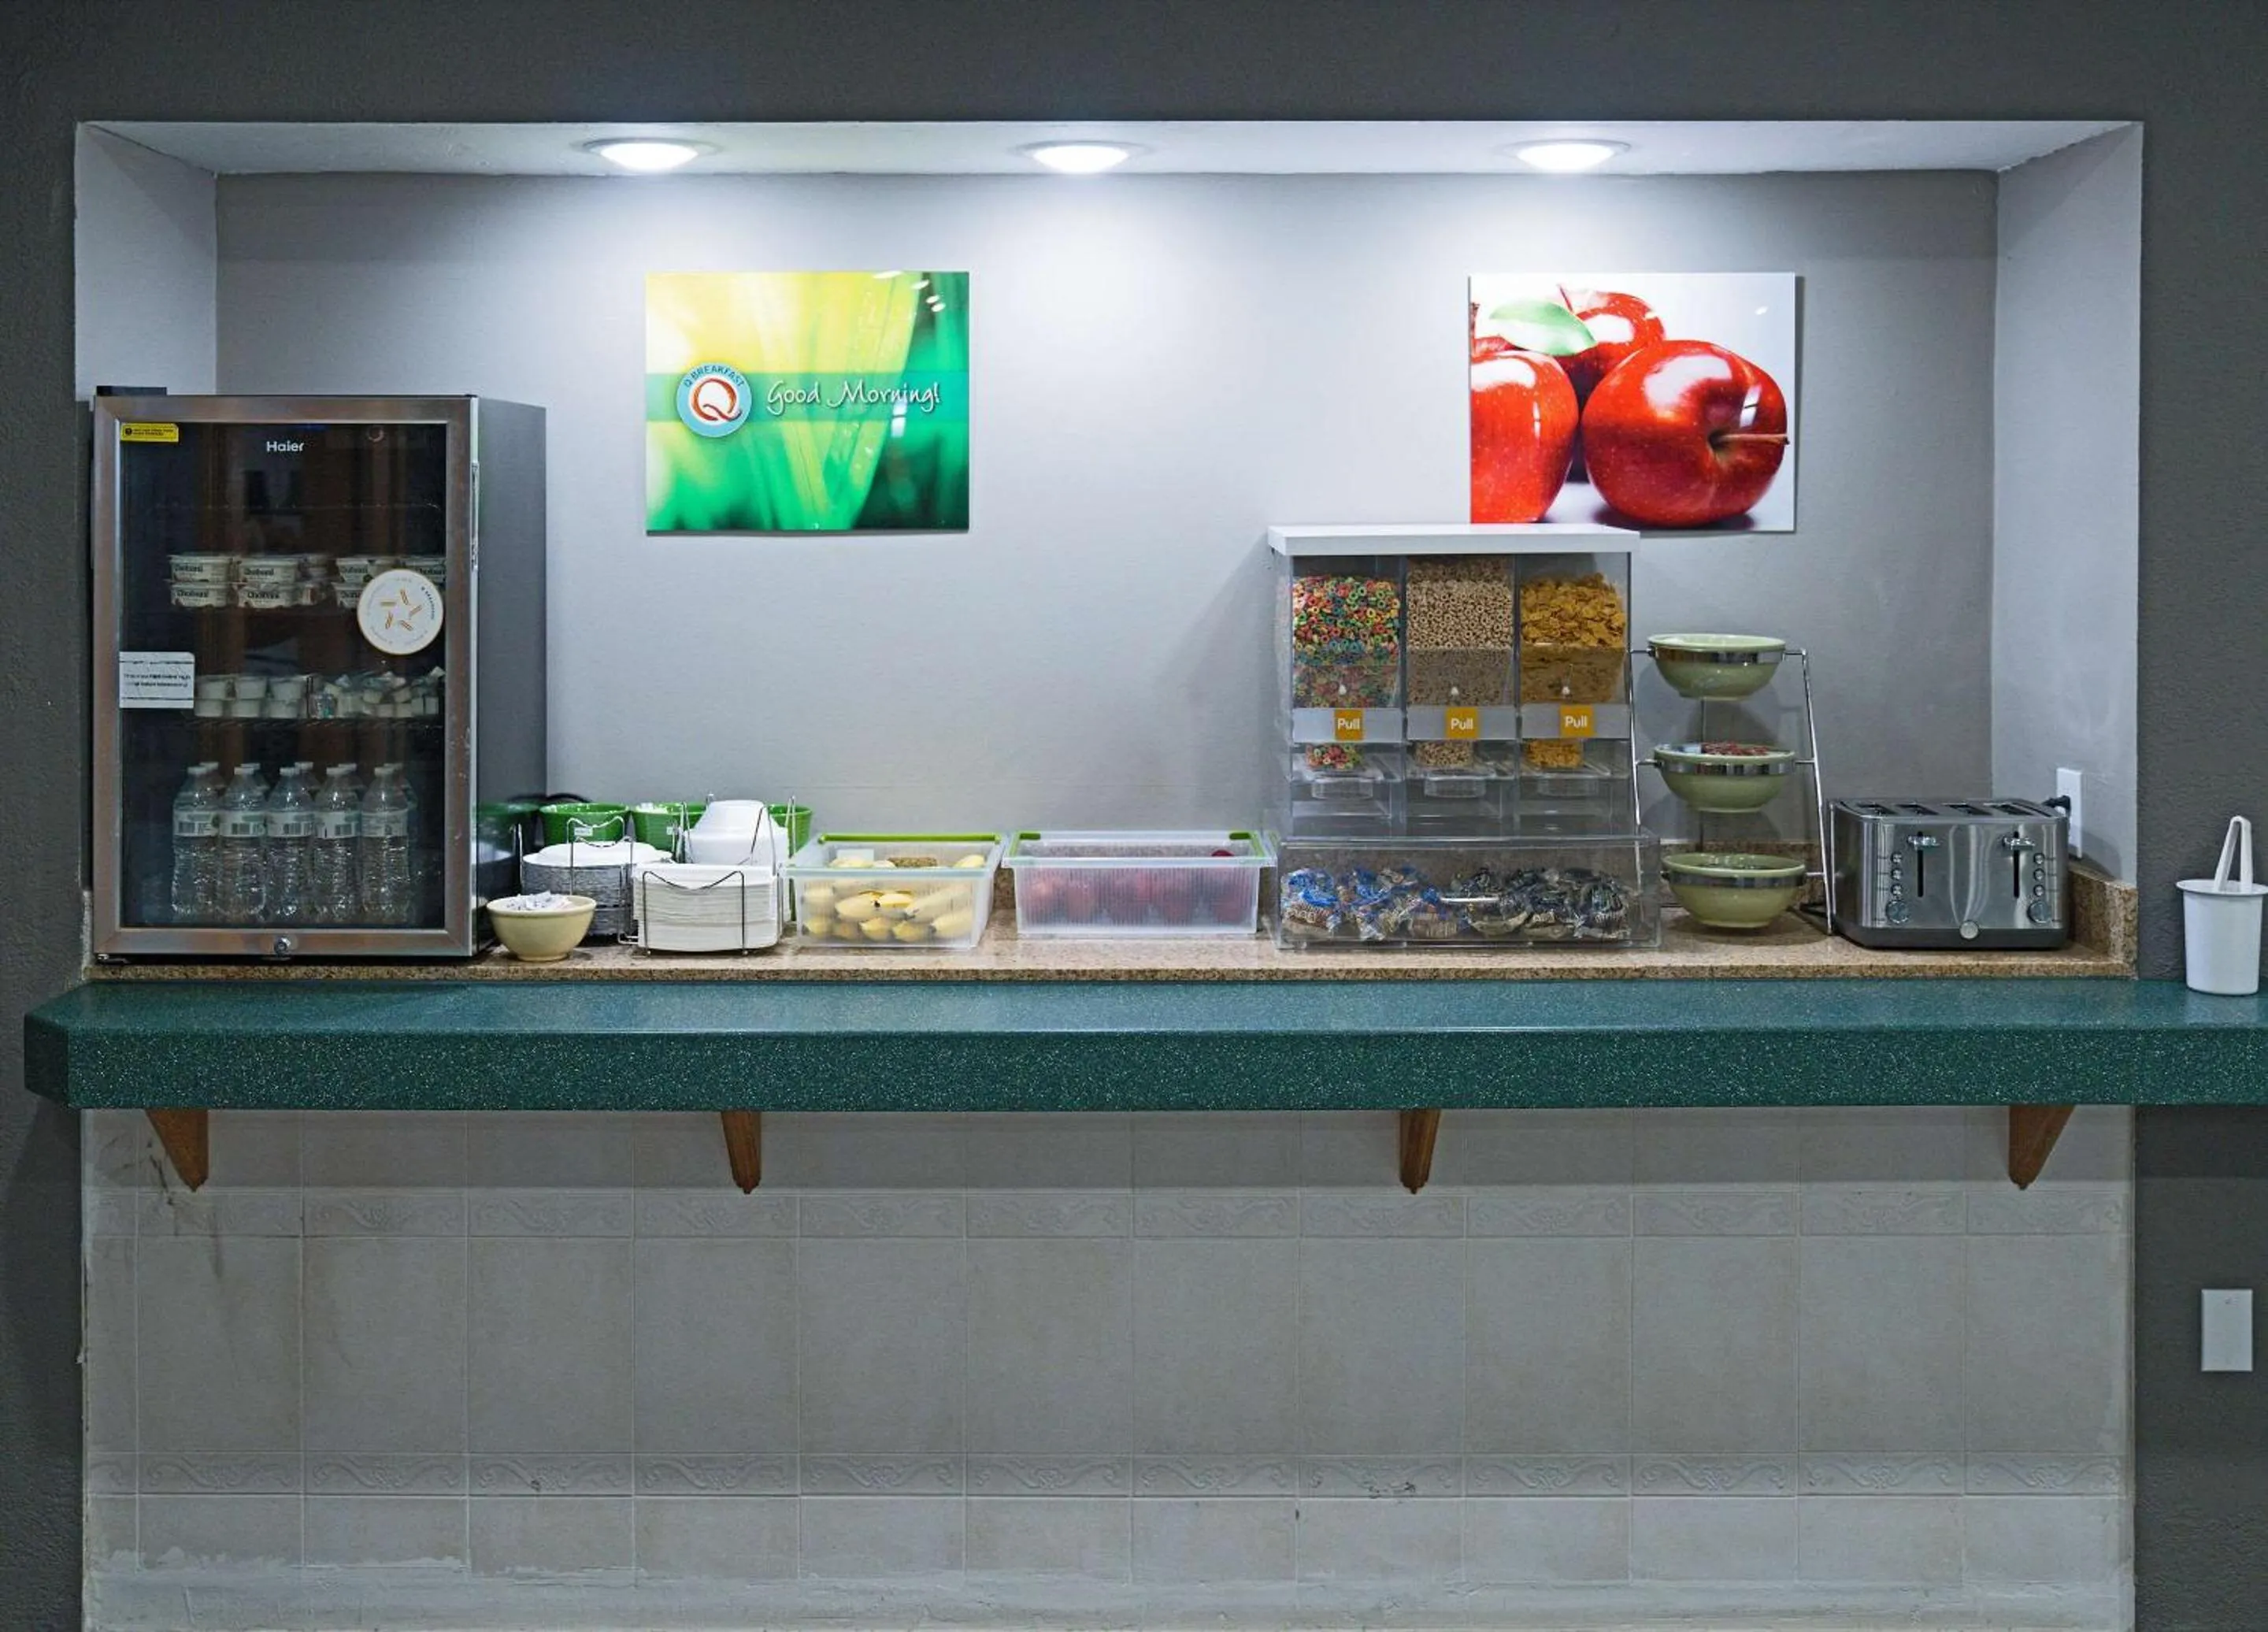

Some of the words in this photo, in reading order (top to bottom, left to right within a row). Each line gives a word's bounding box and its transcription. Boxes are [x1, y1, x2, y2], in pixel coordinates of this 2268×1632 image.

[691, 365, 745, 388] BREAKFAST
[691, 377, 743, 422] Q
[765, 380, 821, 416] Good
[827, 378, 941, 413] Morning!
[266, 440, 305, 453] Haier
[1336, 717, 1361, 730] Pull
[1450, 717, 1474, 730] Pull
[1565, 715, 1588, 729] Pull
